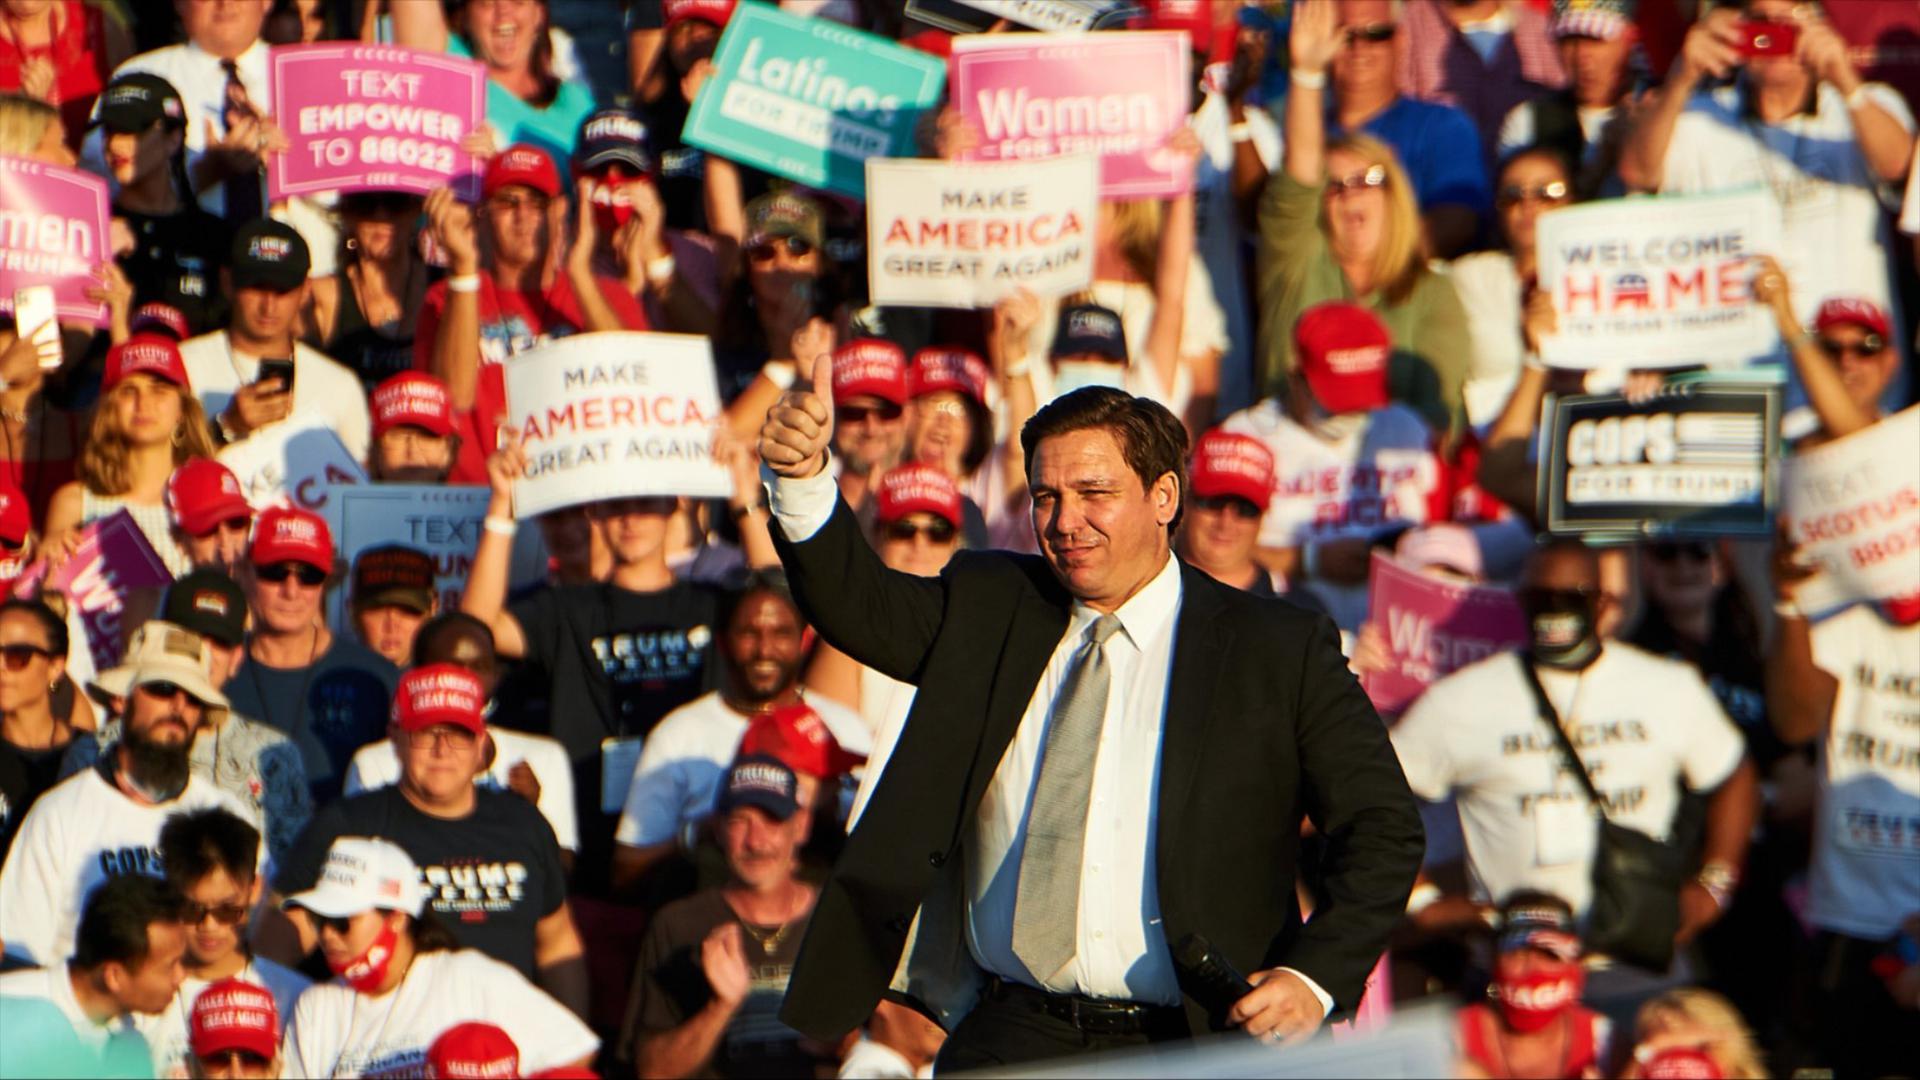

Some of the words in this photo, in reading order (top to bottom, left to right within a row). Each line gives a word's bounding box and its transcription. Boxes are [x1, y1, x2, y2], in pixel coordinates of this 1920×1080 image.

[340, 69, 423, 101] TEXT
[737, 36, 900, 127] Latinos
[299, 102, 463, 144] EMPOWER
[731, 91, 784, 120] FOR
[794, 110, 883, 150] TRUMP
[977, 85, 1157, 141] Women
[308, 137, 353, 168] TO
[359, 135, 456, 175] 88022
[941, 184, 1028, 211] MAKE
[885, 209, 1083, 250] AMERICA
[1560, 233, 1744, 265] WELCOME
[884, 252, 983, 277] GREAT
[993, 245, 1081, 279] AGAIN
[564, 363, 649, 390] MAKE
[520, 396, 706, 446] AMERICA
[1567, 412, 1677, 466] COPS
[522, 441, 610, 479] GREAT
[626, 437, 711, 459] AGAIN
[1573, 471, 1634, 491] FOR
[1650, 471, 1751, 492] TRUMP
[404, 515, 485, 543] TEXT
[1801, 489, 1919, 541] SCOTUS
[417, 863, 527, 889] RUMP
